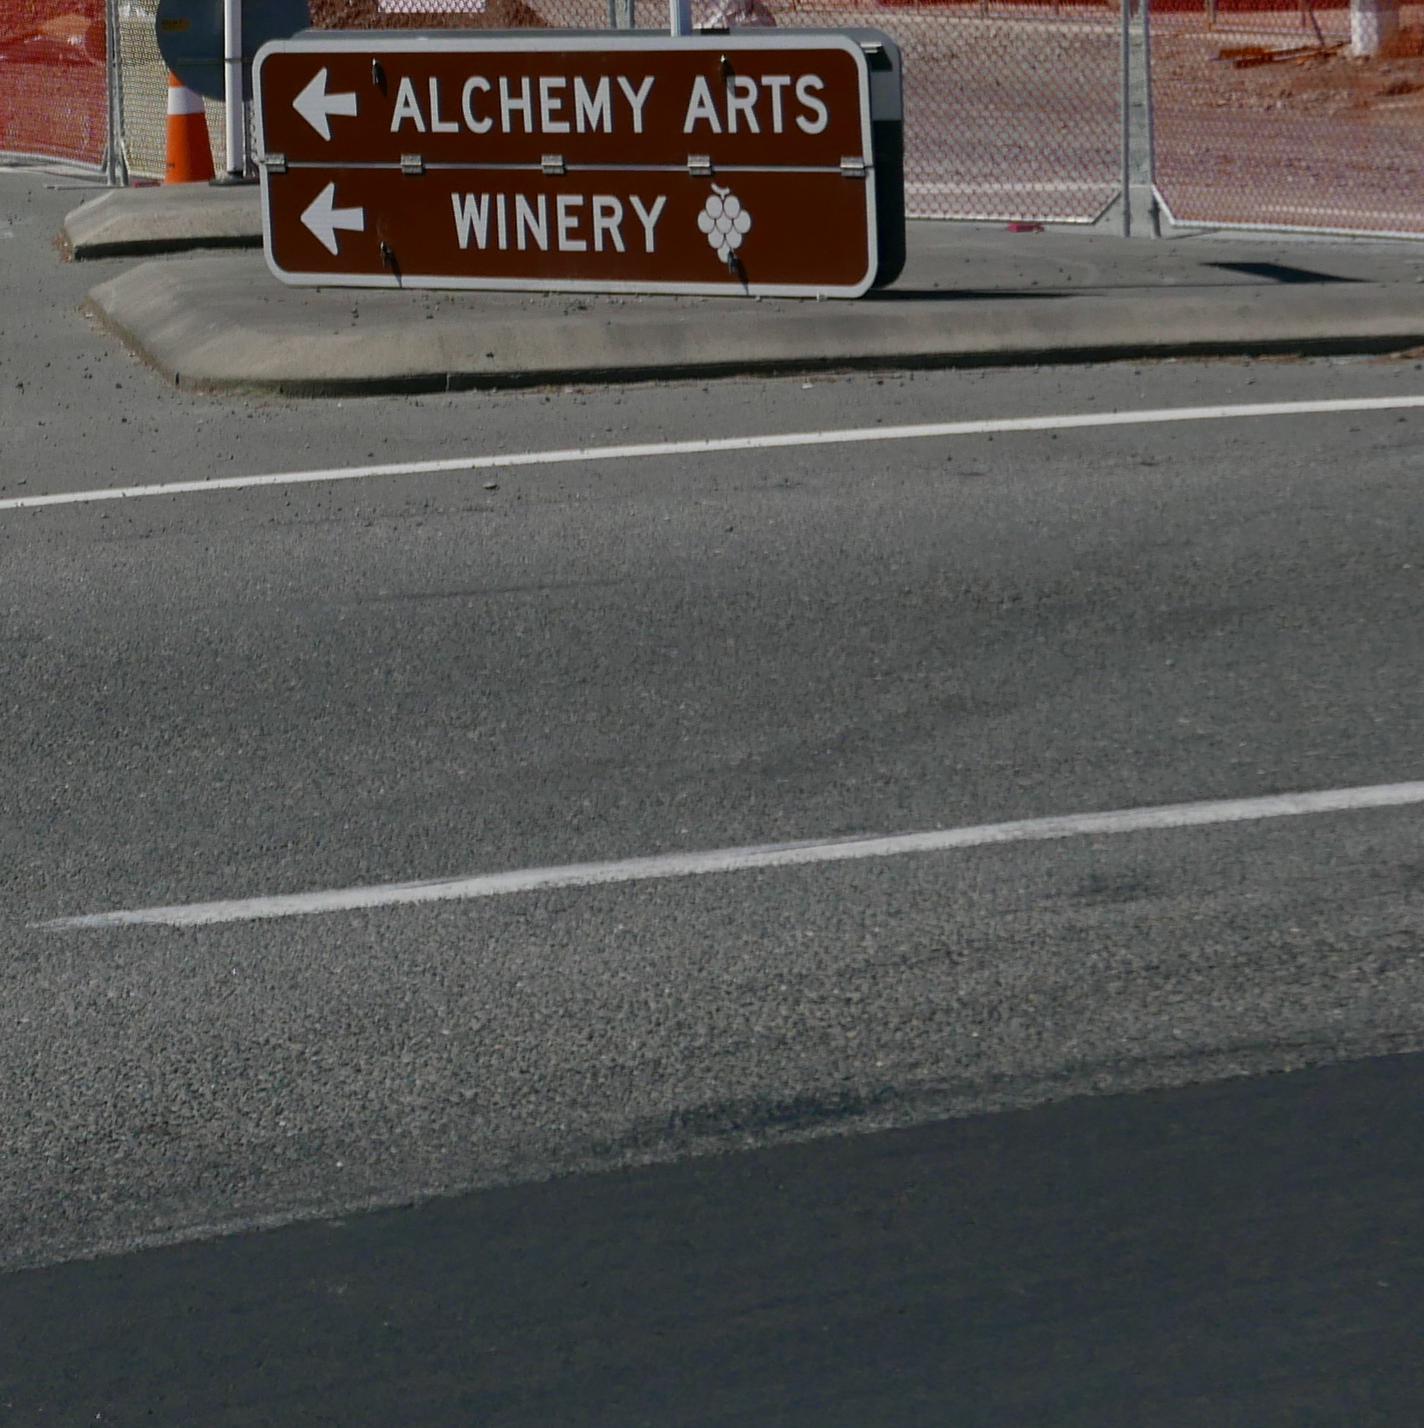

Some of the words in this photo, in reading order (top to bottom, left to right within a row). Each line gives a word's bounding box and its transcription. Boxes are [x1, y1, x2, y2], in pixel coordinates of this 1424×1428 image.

[390, 74, 655, 134] ALCHEMY
[683, 73, 829, 135] ARTS
[450, 192, 668, 254] WINERY
